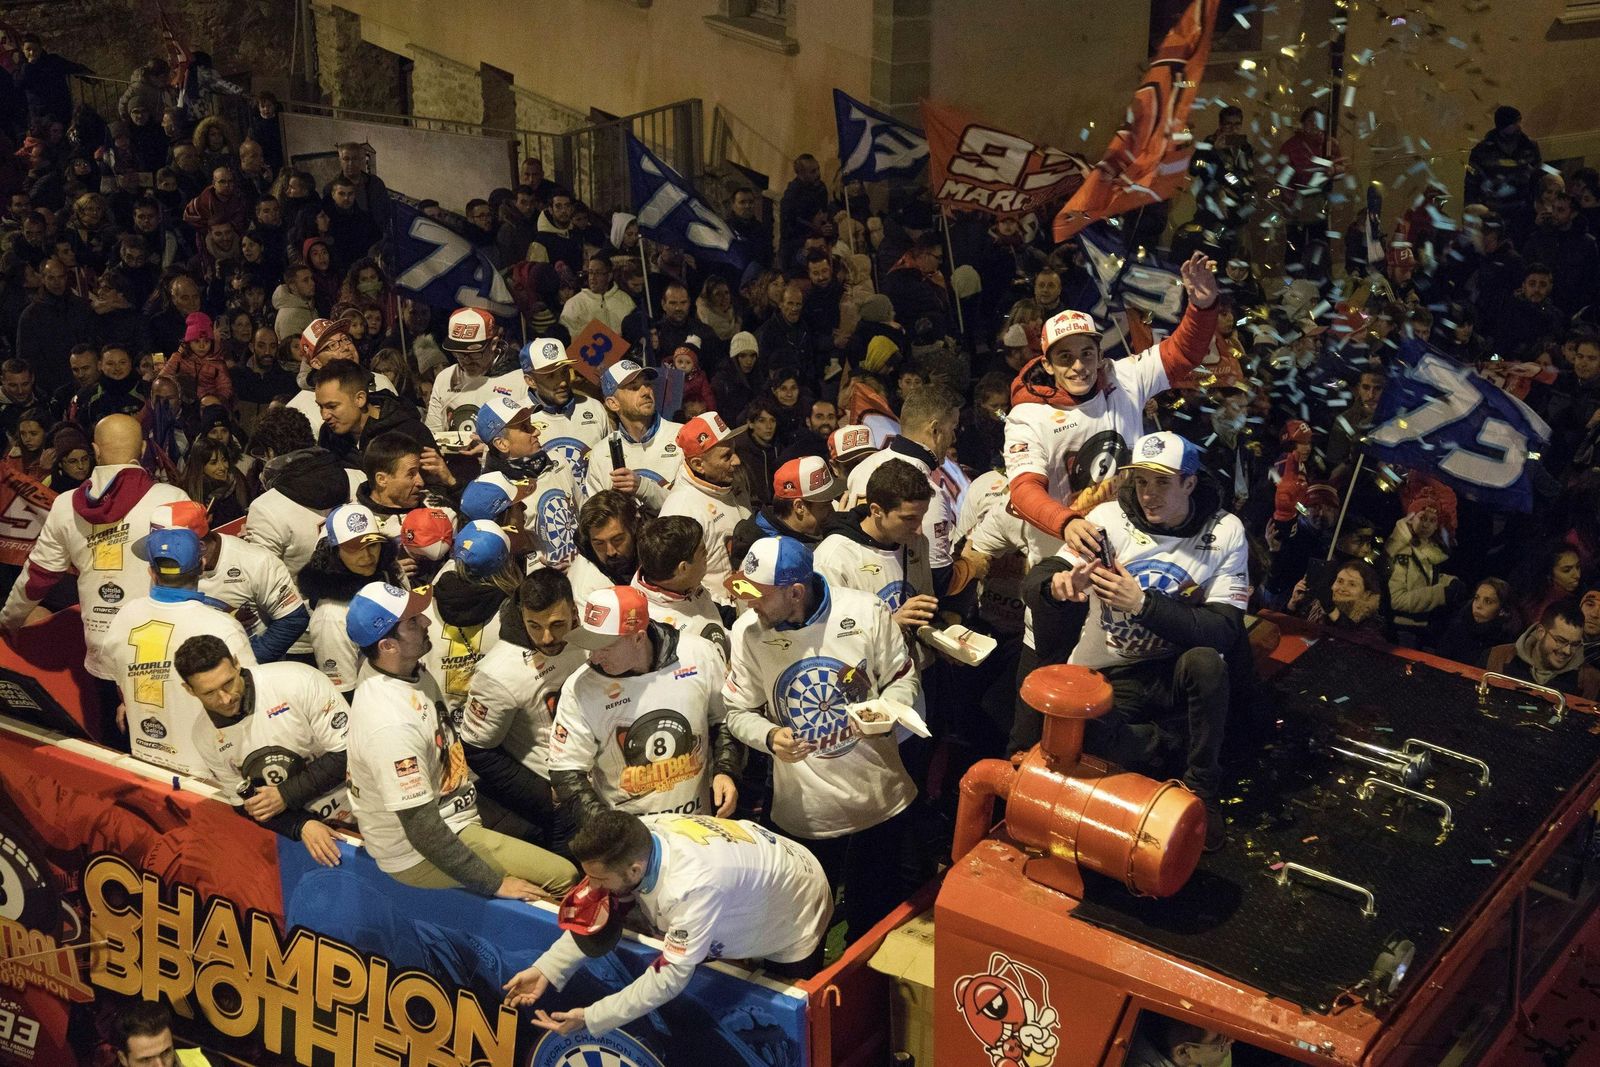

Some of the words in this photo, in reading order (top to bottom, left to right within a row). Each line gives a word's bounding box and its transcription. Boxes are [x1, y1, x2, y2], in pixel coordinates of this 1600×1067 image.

[452, 323, 480, 339] 93
[1054, 325, 1072, 336] Red
[1072, 323, 1089, 332] Bull
[1053, 422, 1078, 434] REPSOL
[842, 430, 869, 451] 93
[86, 531, 130, 549] CHAMPION
[87, 523, 130, 542] WORLD
[128, 661, 172, 672] WORLD
[128, 669, 170, 677] CHAMPION
[534, 664, 556, 682] REPSOL
[673, 666, 698, 680] HRC
[605, 697, 632, 711] REPSOL
[653, 737, 668, 757] 8
[267, 769, 284, 785] 8
[84, 855, 518, 1067] CHAMPION
[545, 1039, 572, 1067] WORLD
[574, 1034, 632, 1057] CHAMPION
